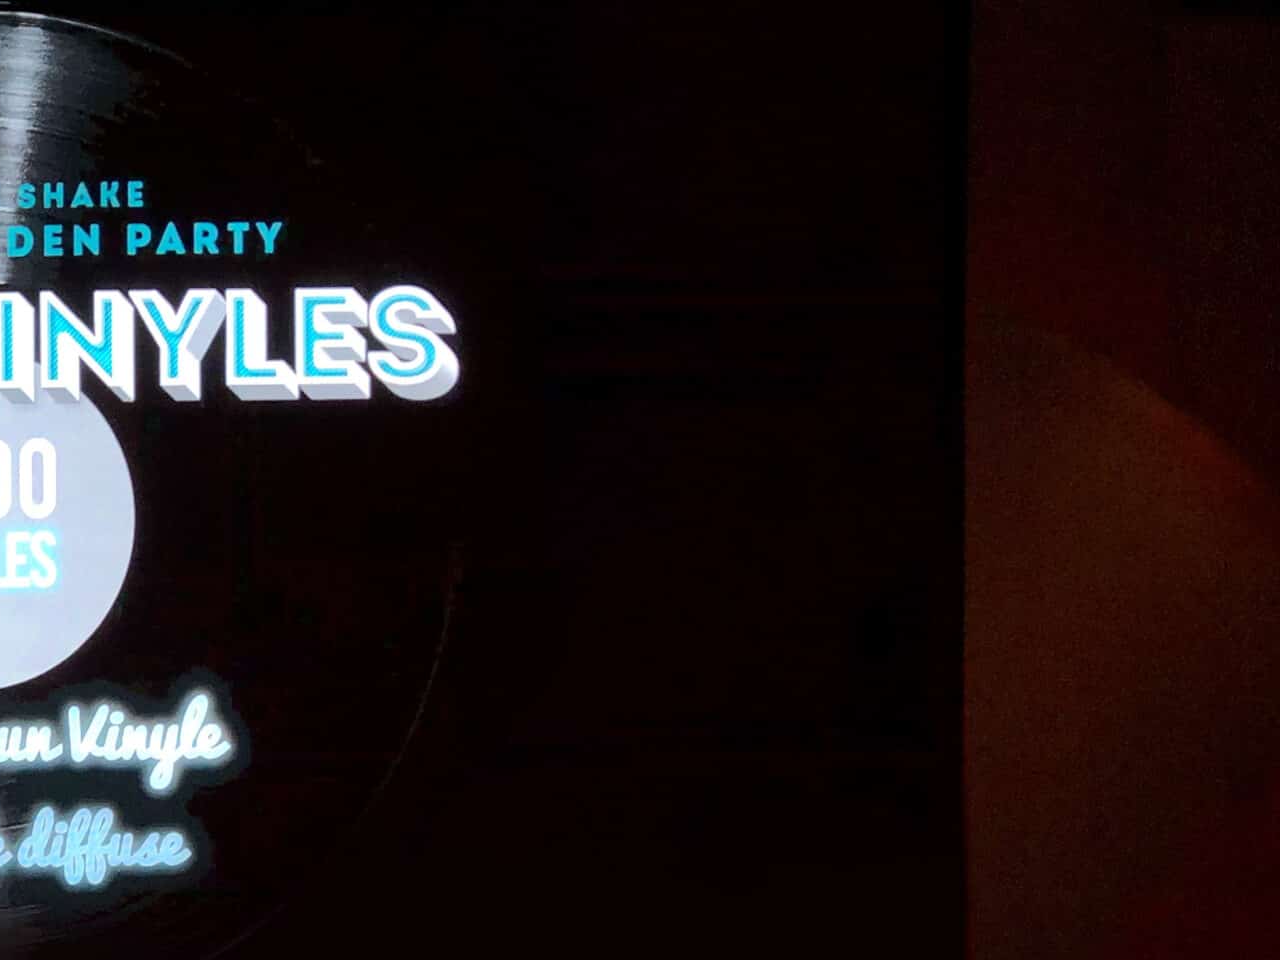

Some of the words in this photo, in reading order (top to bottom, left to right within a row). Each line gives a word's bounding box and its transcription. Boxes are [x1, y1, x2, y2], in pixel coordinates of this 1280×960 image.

[18, 180, 145, 209] SHAKE
[127, 221, 284, 256] PARTY
[66, 693, 233, 792] Vinyle
[17, 805, 193, 887] diffuse
